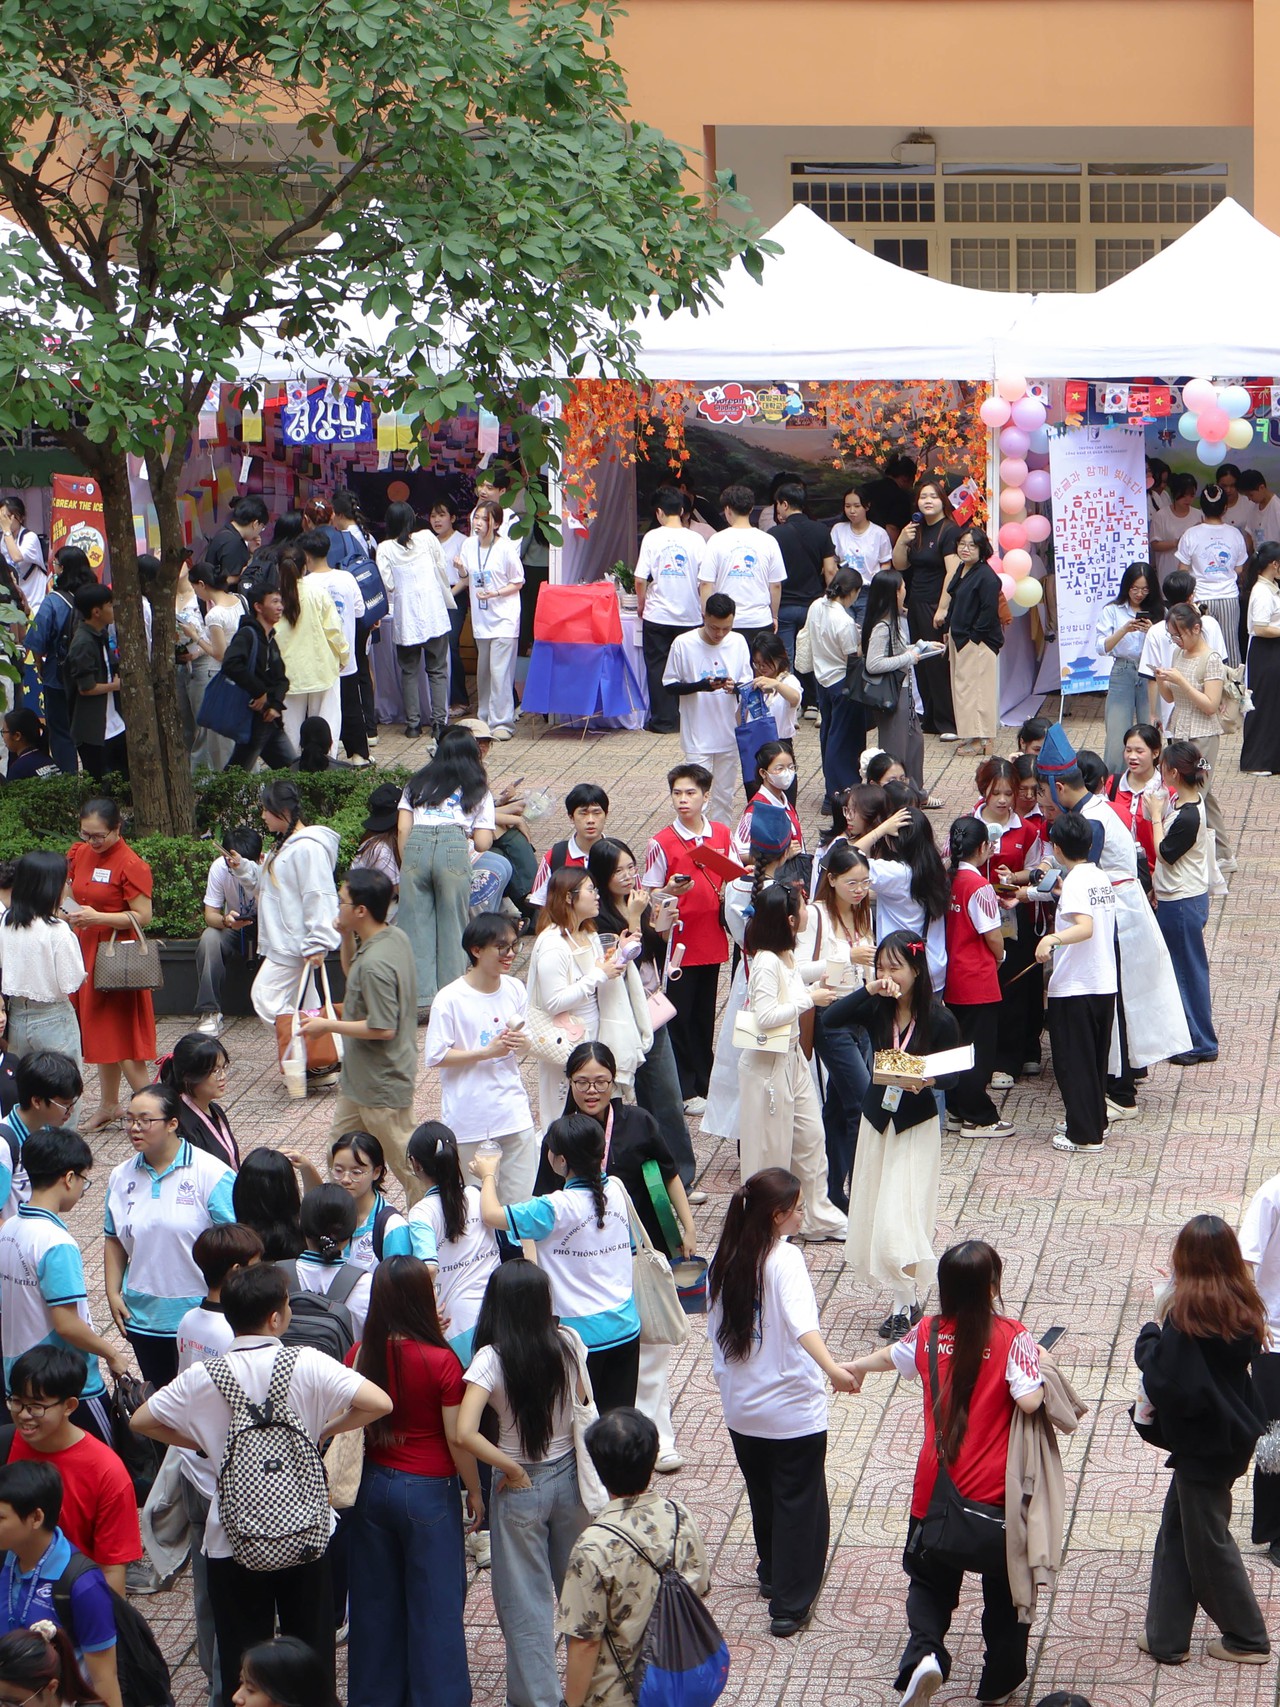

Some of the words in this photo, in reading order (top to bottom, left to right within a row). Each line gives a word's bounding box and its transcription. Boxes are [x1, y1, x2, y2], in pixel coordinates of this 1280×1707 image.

[1086, 465, 1108, 477] 함께
[56, 498, 77, 509] BREAK
[79, 501, 92, 510] THE
[92, 503, 103, 512] ICE
[52, 519, 63, 531] NEW
[53, 526, 67, 543] MENU
[442, 1260, 470, 1273] THÔNG
[924, 1341, 954, 1355] HNG
